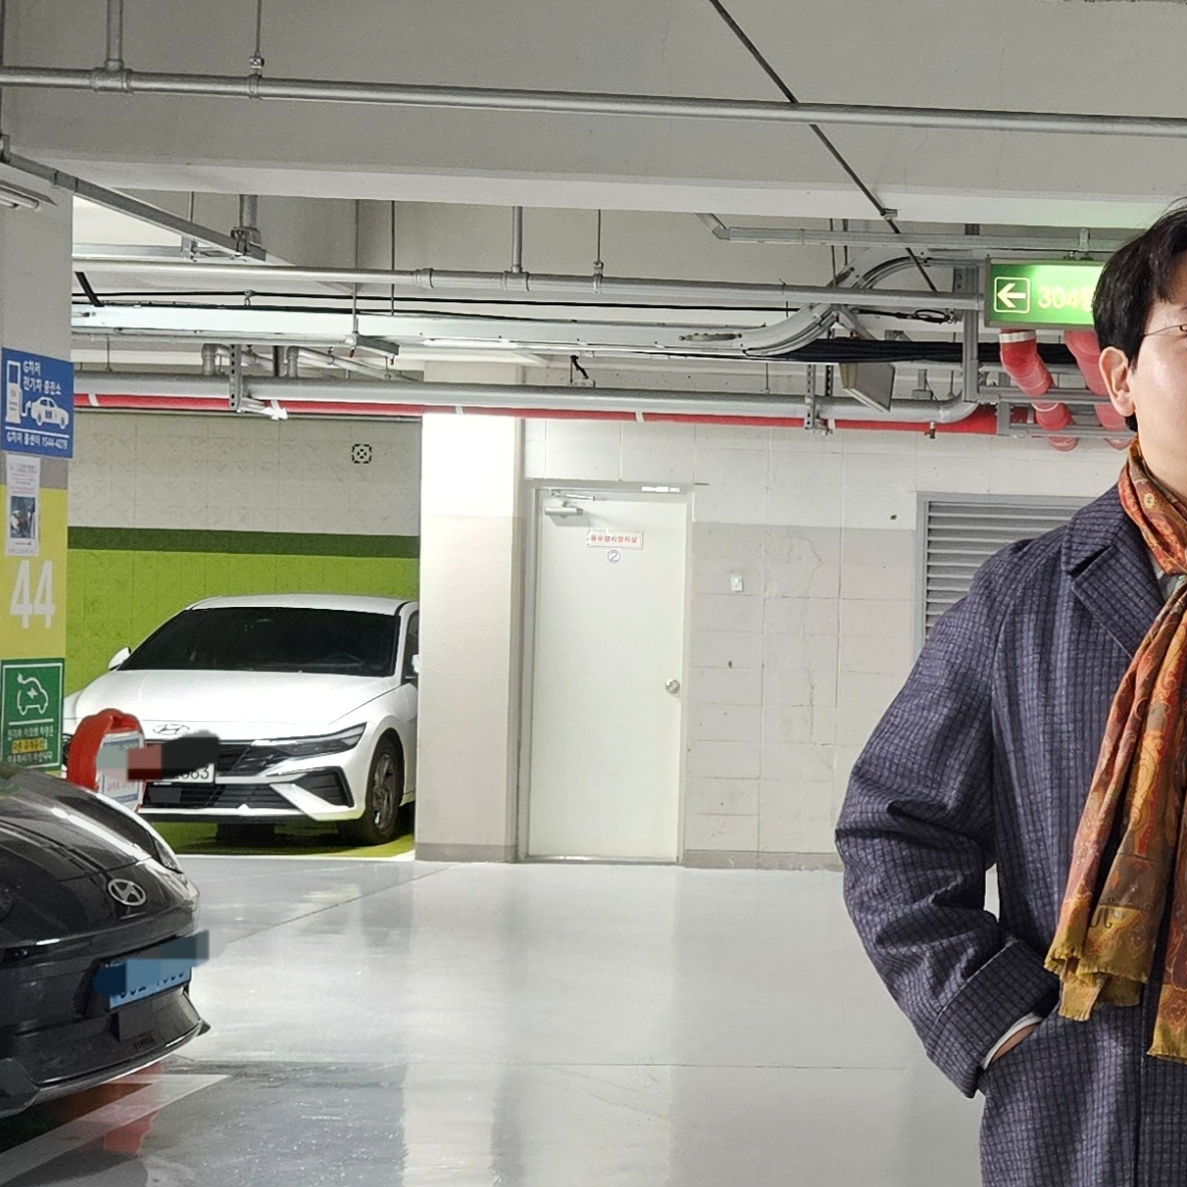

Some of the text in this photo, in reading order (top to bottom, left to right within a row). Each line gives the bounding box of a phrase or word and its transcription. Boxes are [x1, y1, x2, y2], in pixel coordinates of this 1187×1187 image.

[23, 376, 62, 395] 전기차 충전소
[9, 559, 56, 629] 44
